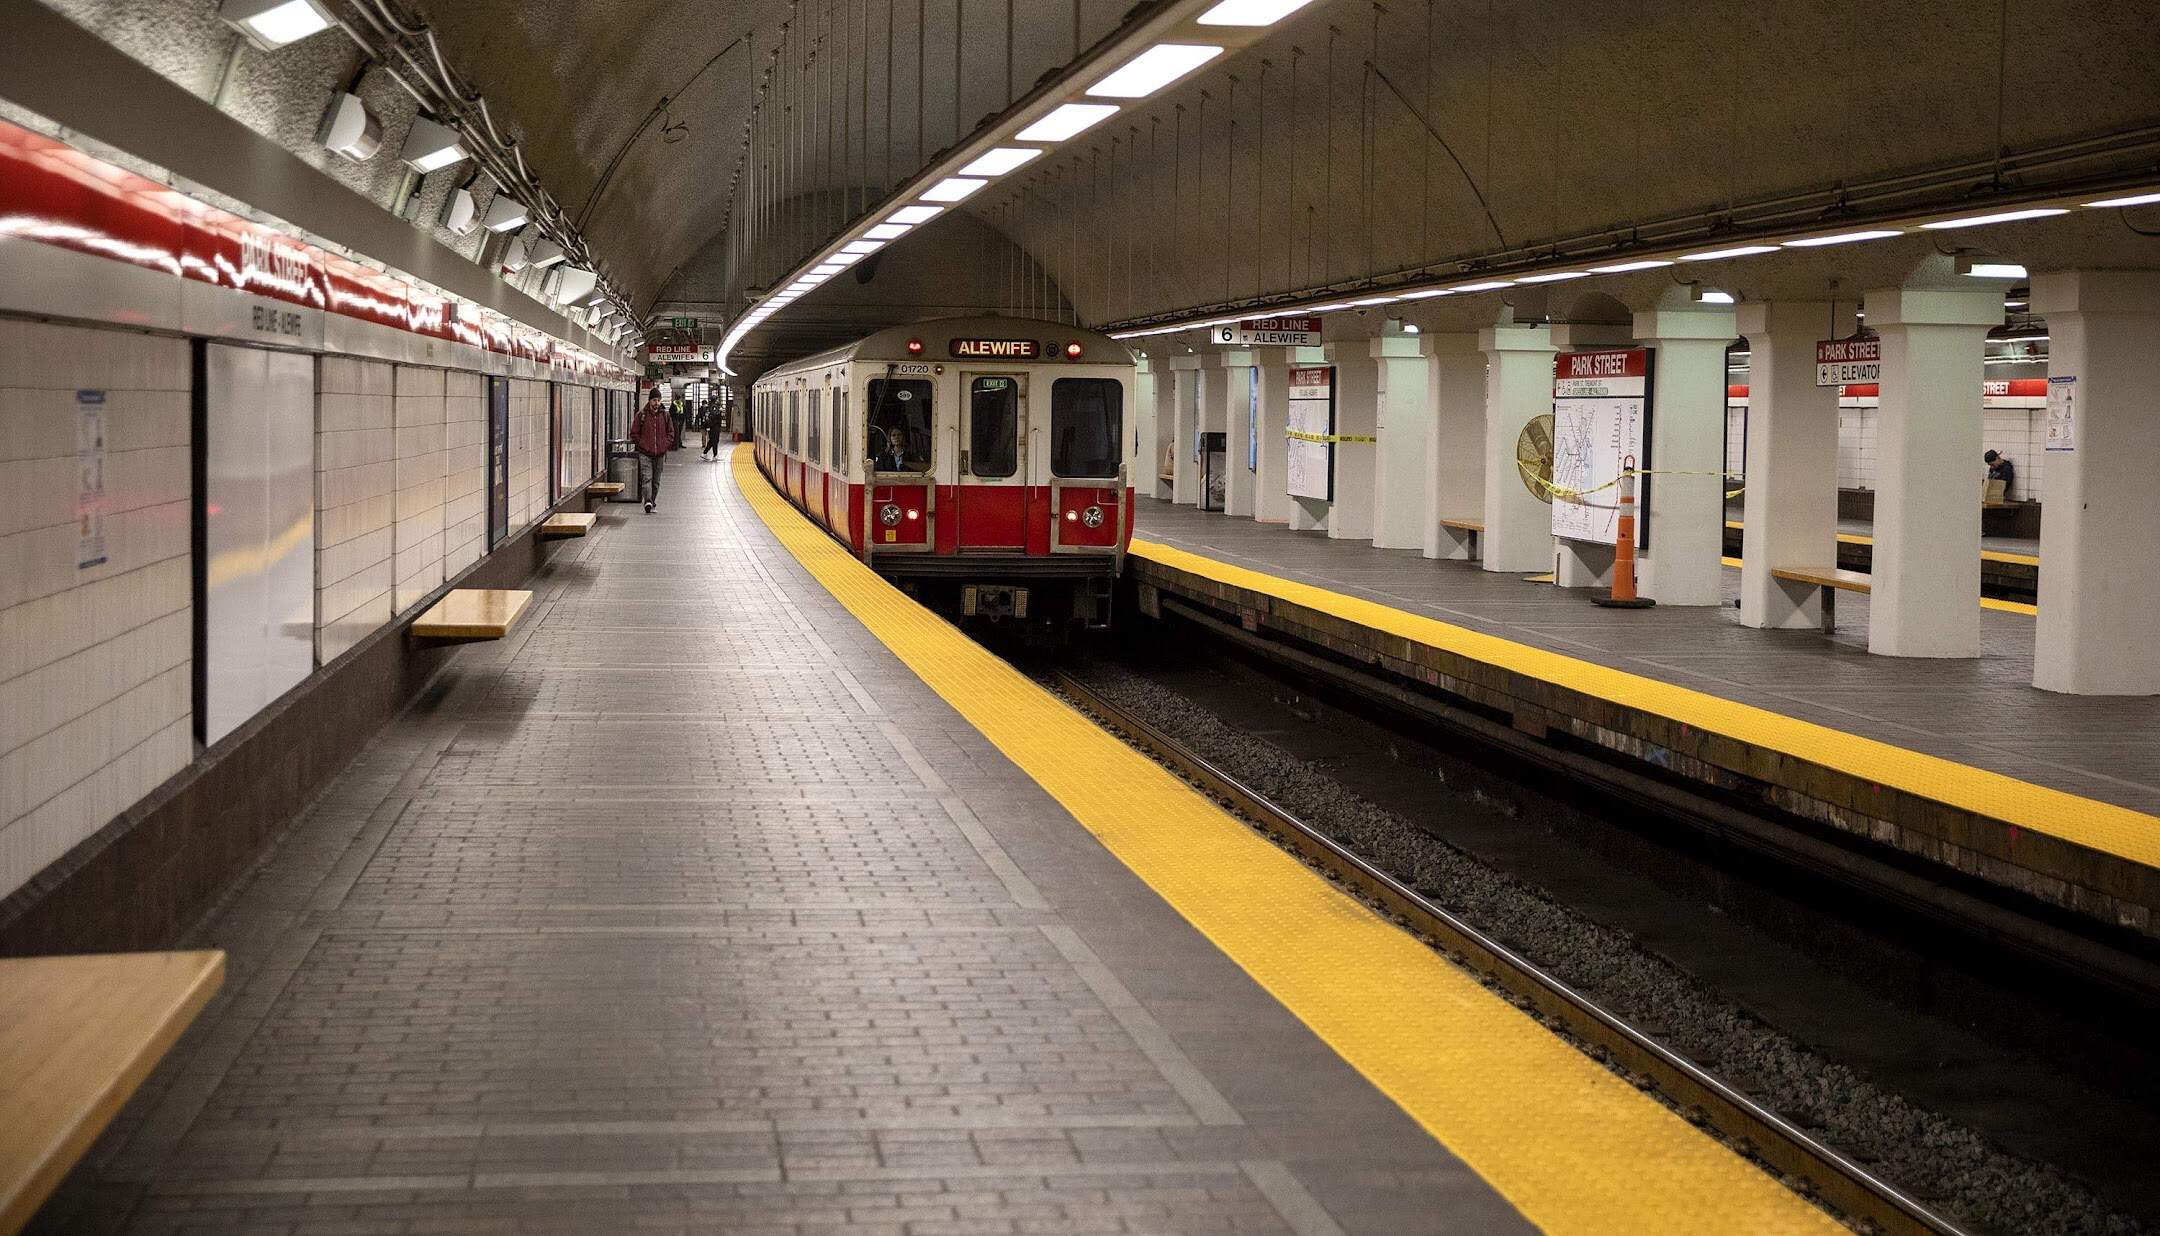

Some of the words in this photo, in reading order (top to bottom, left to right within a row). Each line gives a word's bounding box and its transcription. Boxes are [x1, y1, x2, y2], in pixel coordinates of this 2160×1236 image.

[273, 241, 310, 289] STREET
[1253, 319, 1278, 330] RED
[1282, 319, 1310, 331] LINE
[1221, 327, 1233, 342] 6
[1253, 332, 1308, 344] ALEWIFE
[958, 341, 1031, 355] ALEWIFE
[1825, 343, 1847, 360] PARK
[702, 352, 709, 361] 6
[901, 364, 929, 374] 01720
[1571, 355, 1593, 376] PARK
[1594, 353, 1628, 375] STREET
